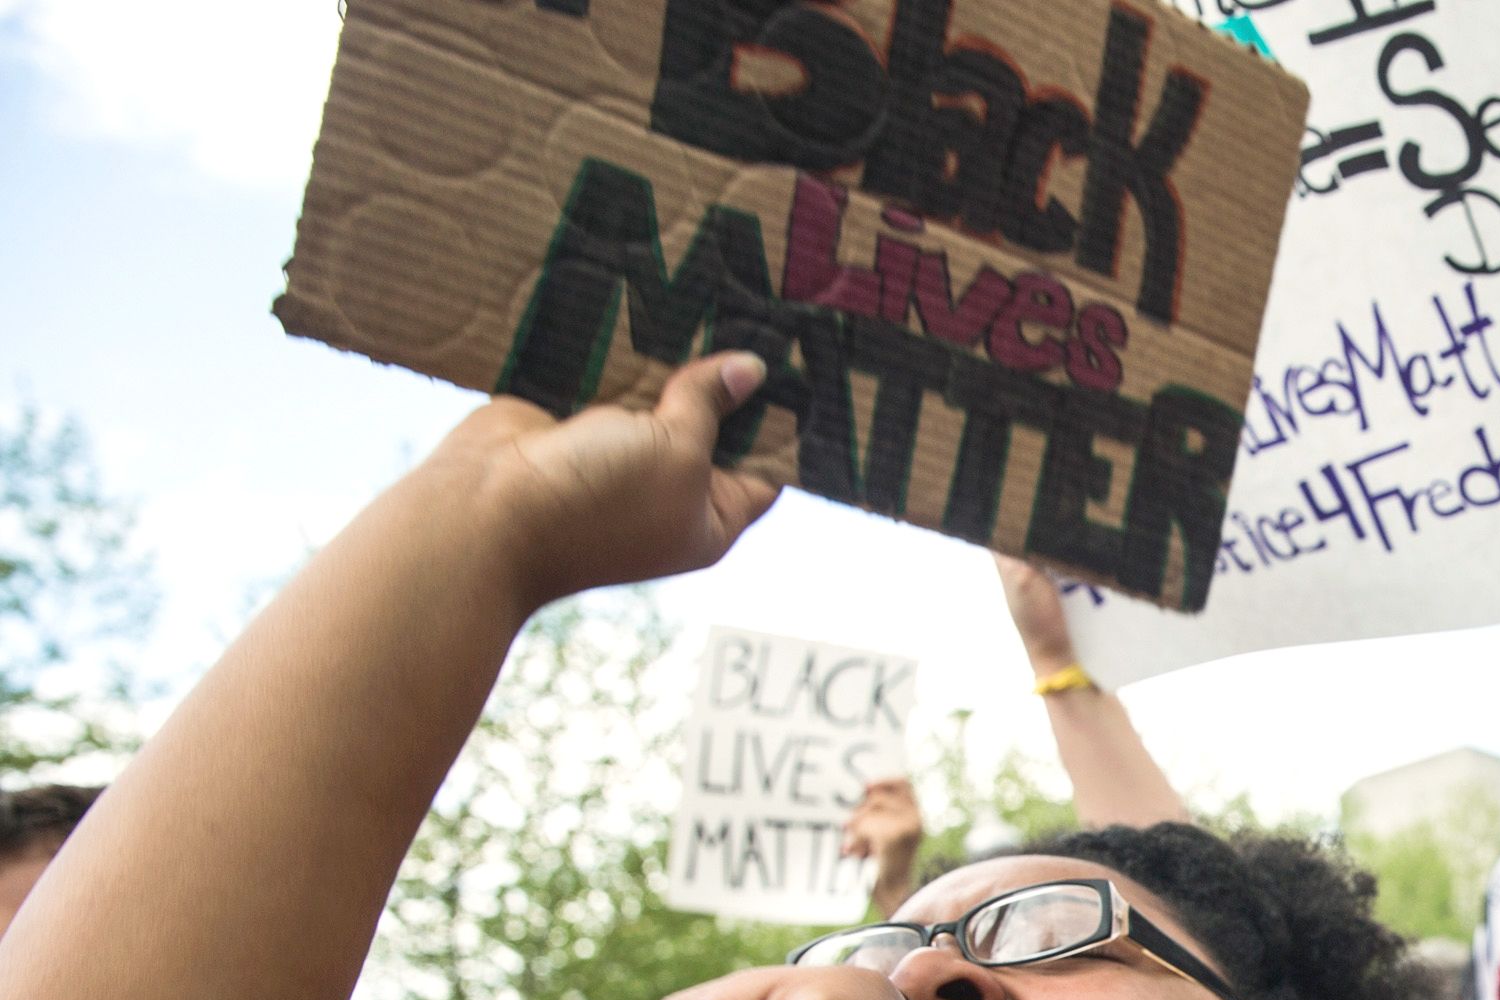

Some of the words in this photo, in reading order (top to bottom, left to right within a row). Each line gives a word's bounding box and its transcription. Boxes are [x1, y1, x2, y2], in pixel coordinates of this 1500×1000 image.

[649, 0, 1210, 328] Black
[780, 168, 1128, 393] Lives
[494, 157, 1246, 614] MATTER
[708, 635, 913, 732] BLACK
[697, 728, 880, 808] LIVES
[684, 817, 874, 896] MATT
